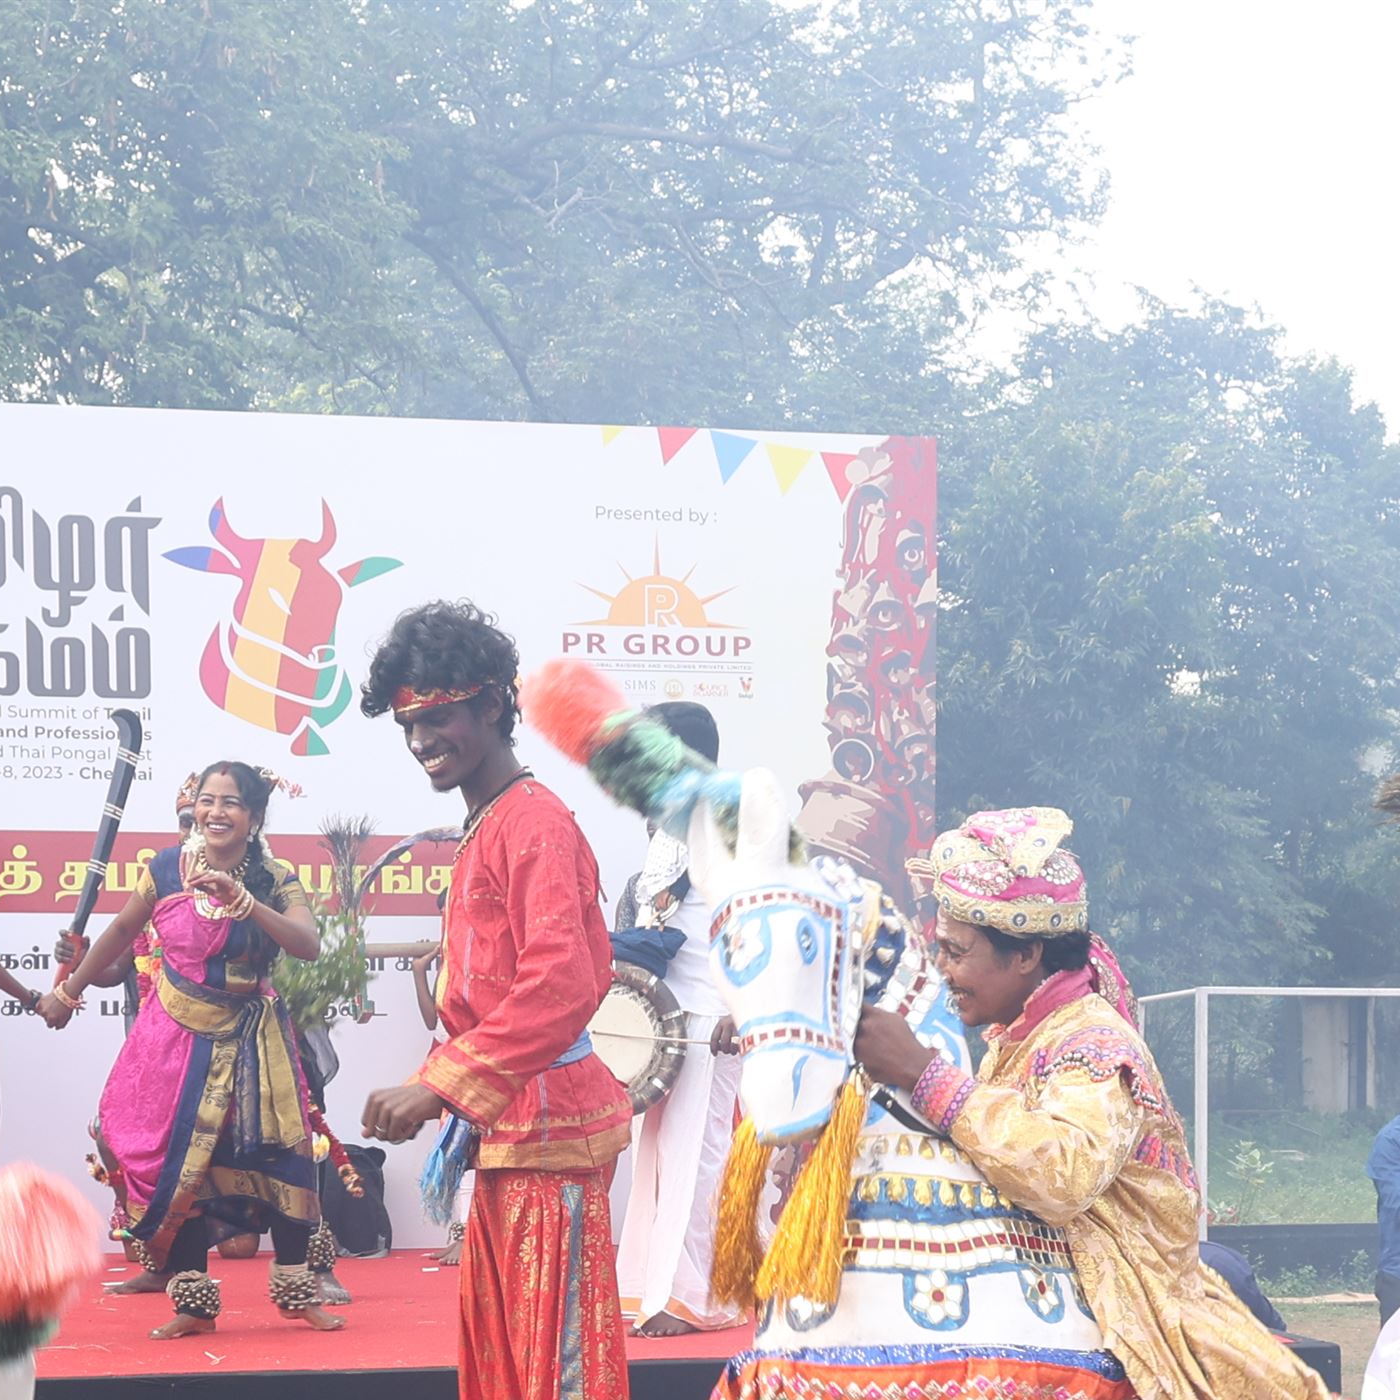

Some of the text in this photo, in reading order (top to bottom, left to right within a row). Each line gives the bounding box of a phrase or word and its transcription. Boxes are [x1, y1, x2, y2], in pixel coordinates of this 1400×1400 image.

[594, 505, 683, 522] Presented
[688, 507, 708, 526] by
[562, 632, 752, 657] PR GROUP
[624, 679, 657, 691] SIMS
[7, 704, 78, 720] Summit
[82, 706, 100, 720] of
[103, 707, 151, 721] Til
[35, 726, 152, 741] Professios
[9, 745, 46, 760] Thai
[51, 746, 112, 763] Pongal
[22, 766, 63, 780] 2023
[79, 766, 152, 782] Cheai
